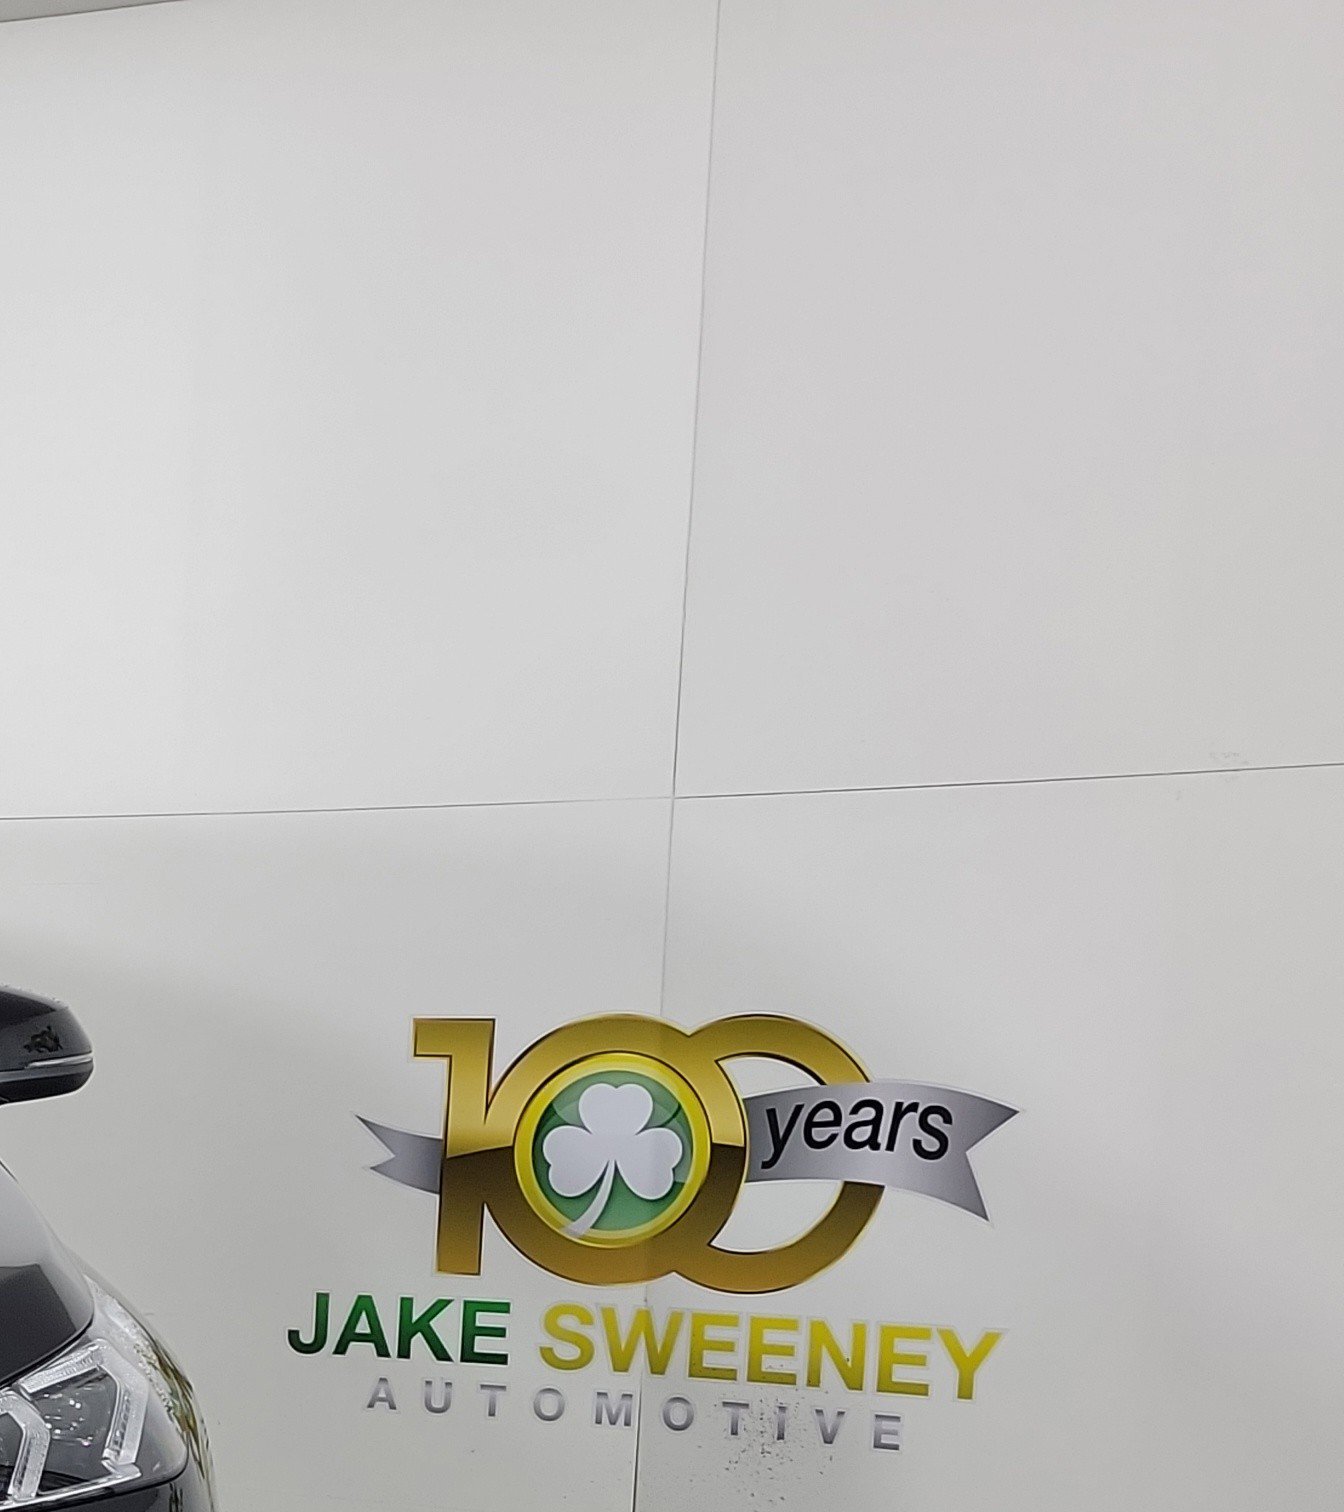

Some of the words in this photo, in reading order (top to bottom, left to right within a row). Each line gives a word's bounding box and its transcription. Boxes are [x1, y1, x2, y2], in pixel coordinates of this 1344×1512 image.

[412, 1012, 885, 1294] 100
[760, 1098, 953, 1169] years
[287, 1291, 511, 1366] JAKE
[539, 1303, 1001, 1401] SWEENEY
[367, 1376, 902, 1452] AUTOMOTIVE
